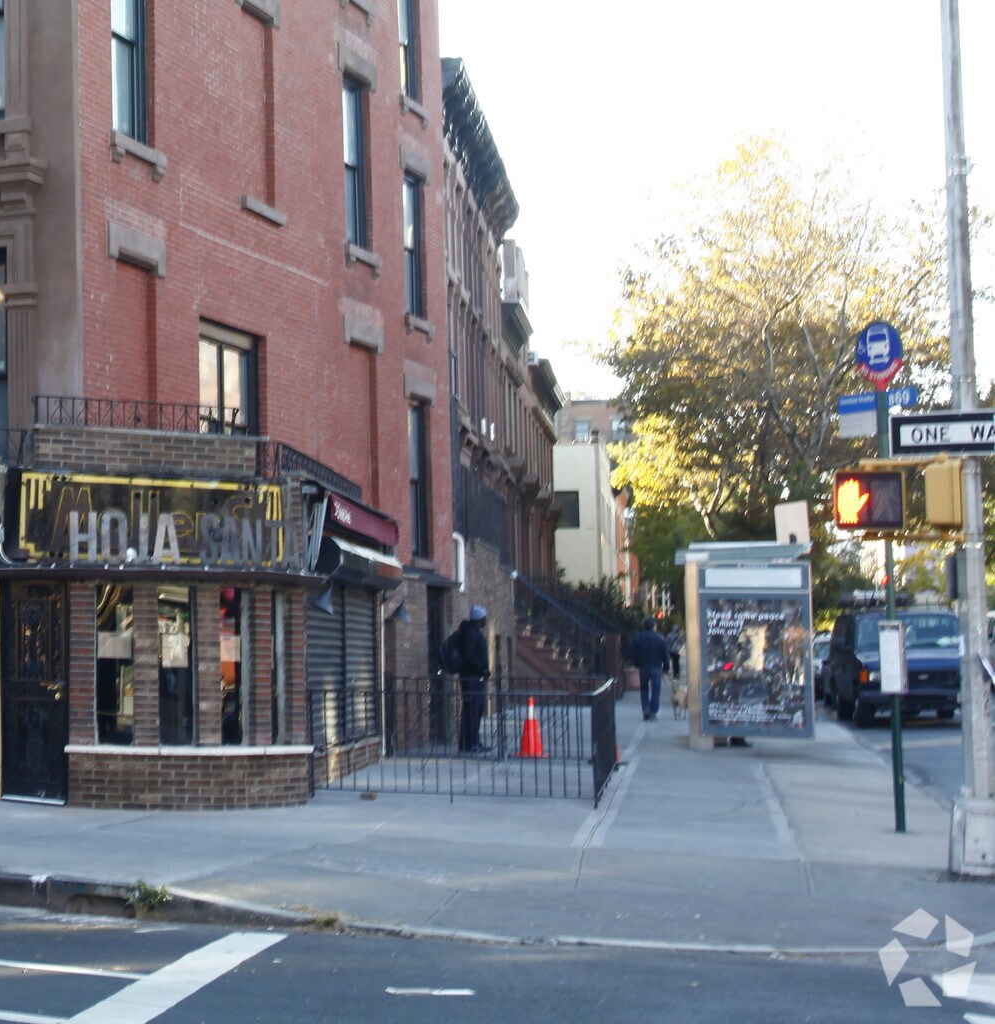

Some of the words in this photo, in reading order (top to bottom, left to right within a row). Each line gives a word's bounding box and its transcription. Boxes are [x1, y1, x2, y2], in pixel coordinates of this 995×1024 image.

[910, 425, 952, 444] ONE
[69, 510, 182, 564] HOJA
[707, 609, 732, 620] Need
